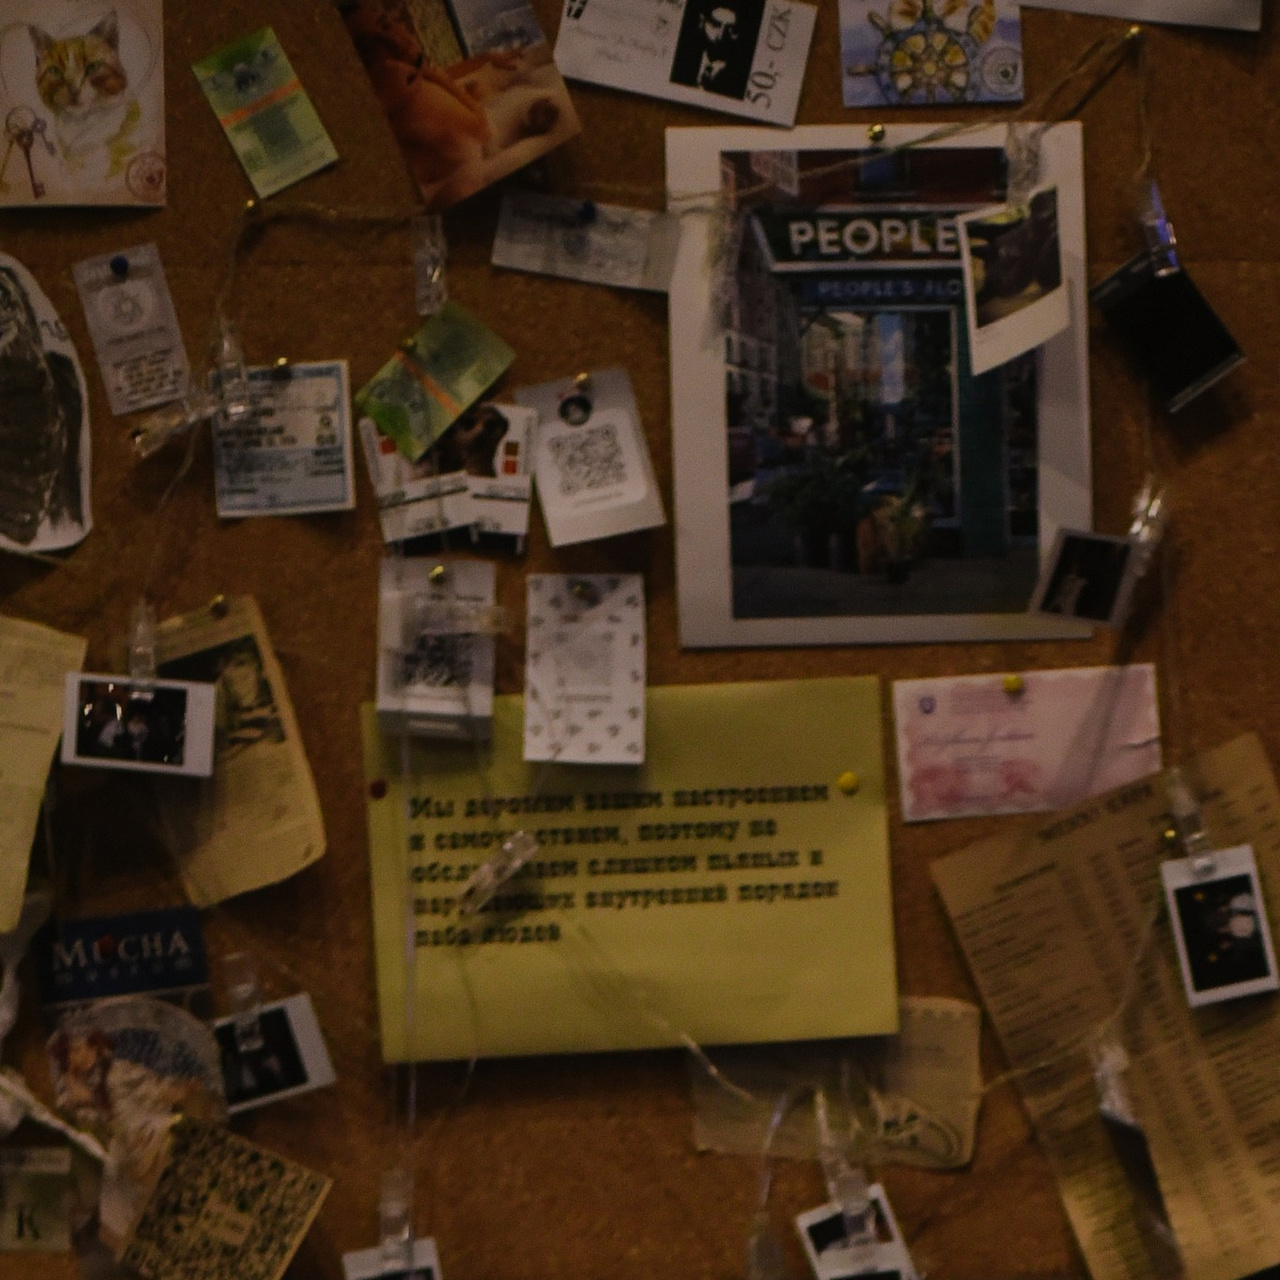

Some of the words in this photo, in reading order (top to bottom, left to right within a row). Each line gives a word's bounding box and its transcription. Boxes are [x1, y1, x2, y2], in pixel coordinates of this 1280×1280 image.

[410, 798, 454, 818] Мы
[673, 785, 829, 808] настроением
[638, 820, 740, 842] поэтому
[749, 819, 776, 836] не
[588, 858, 696, 876] слишком
[739, 881, 838, 903] порядок
